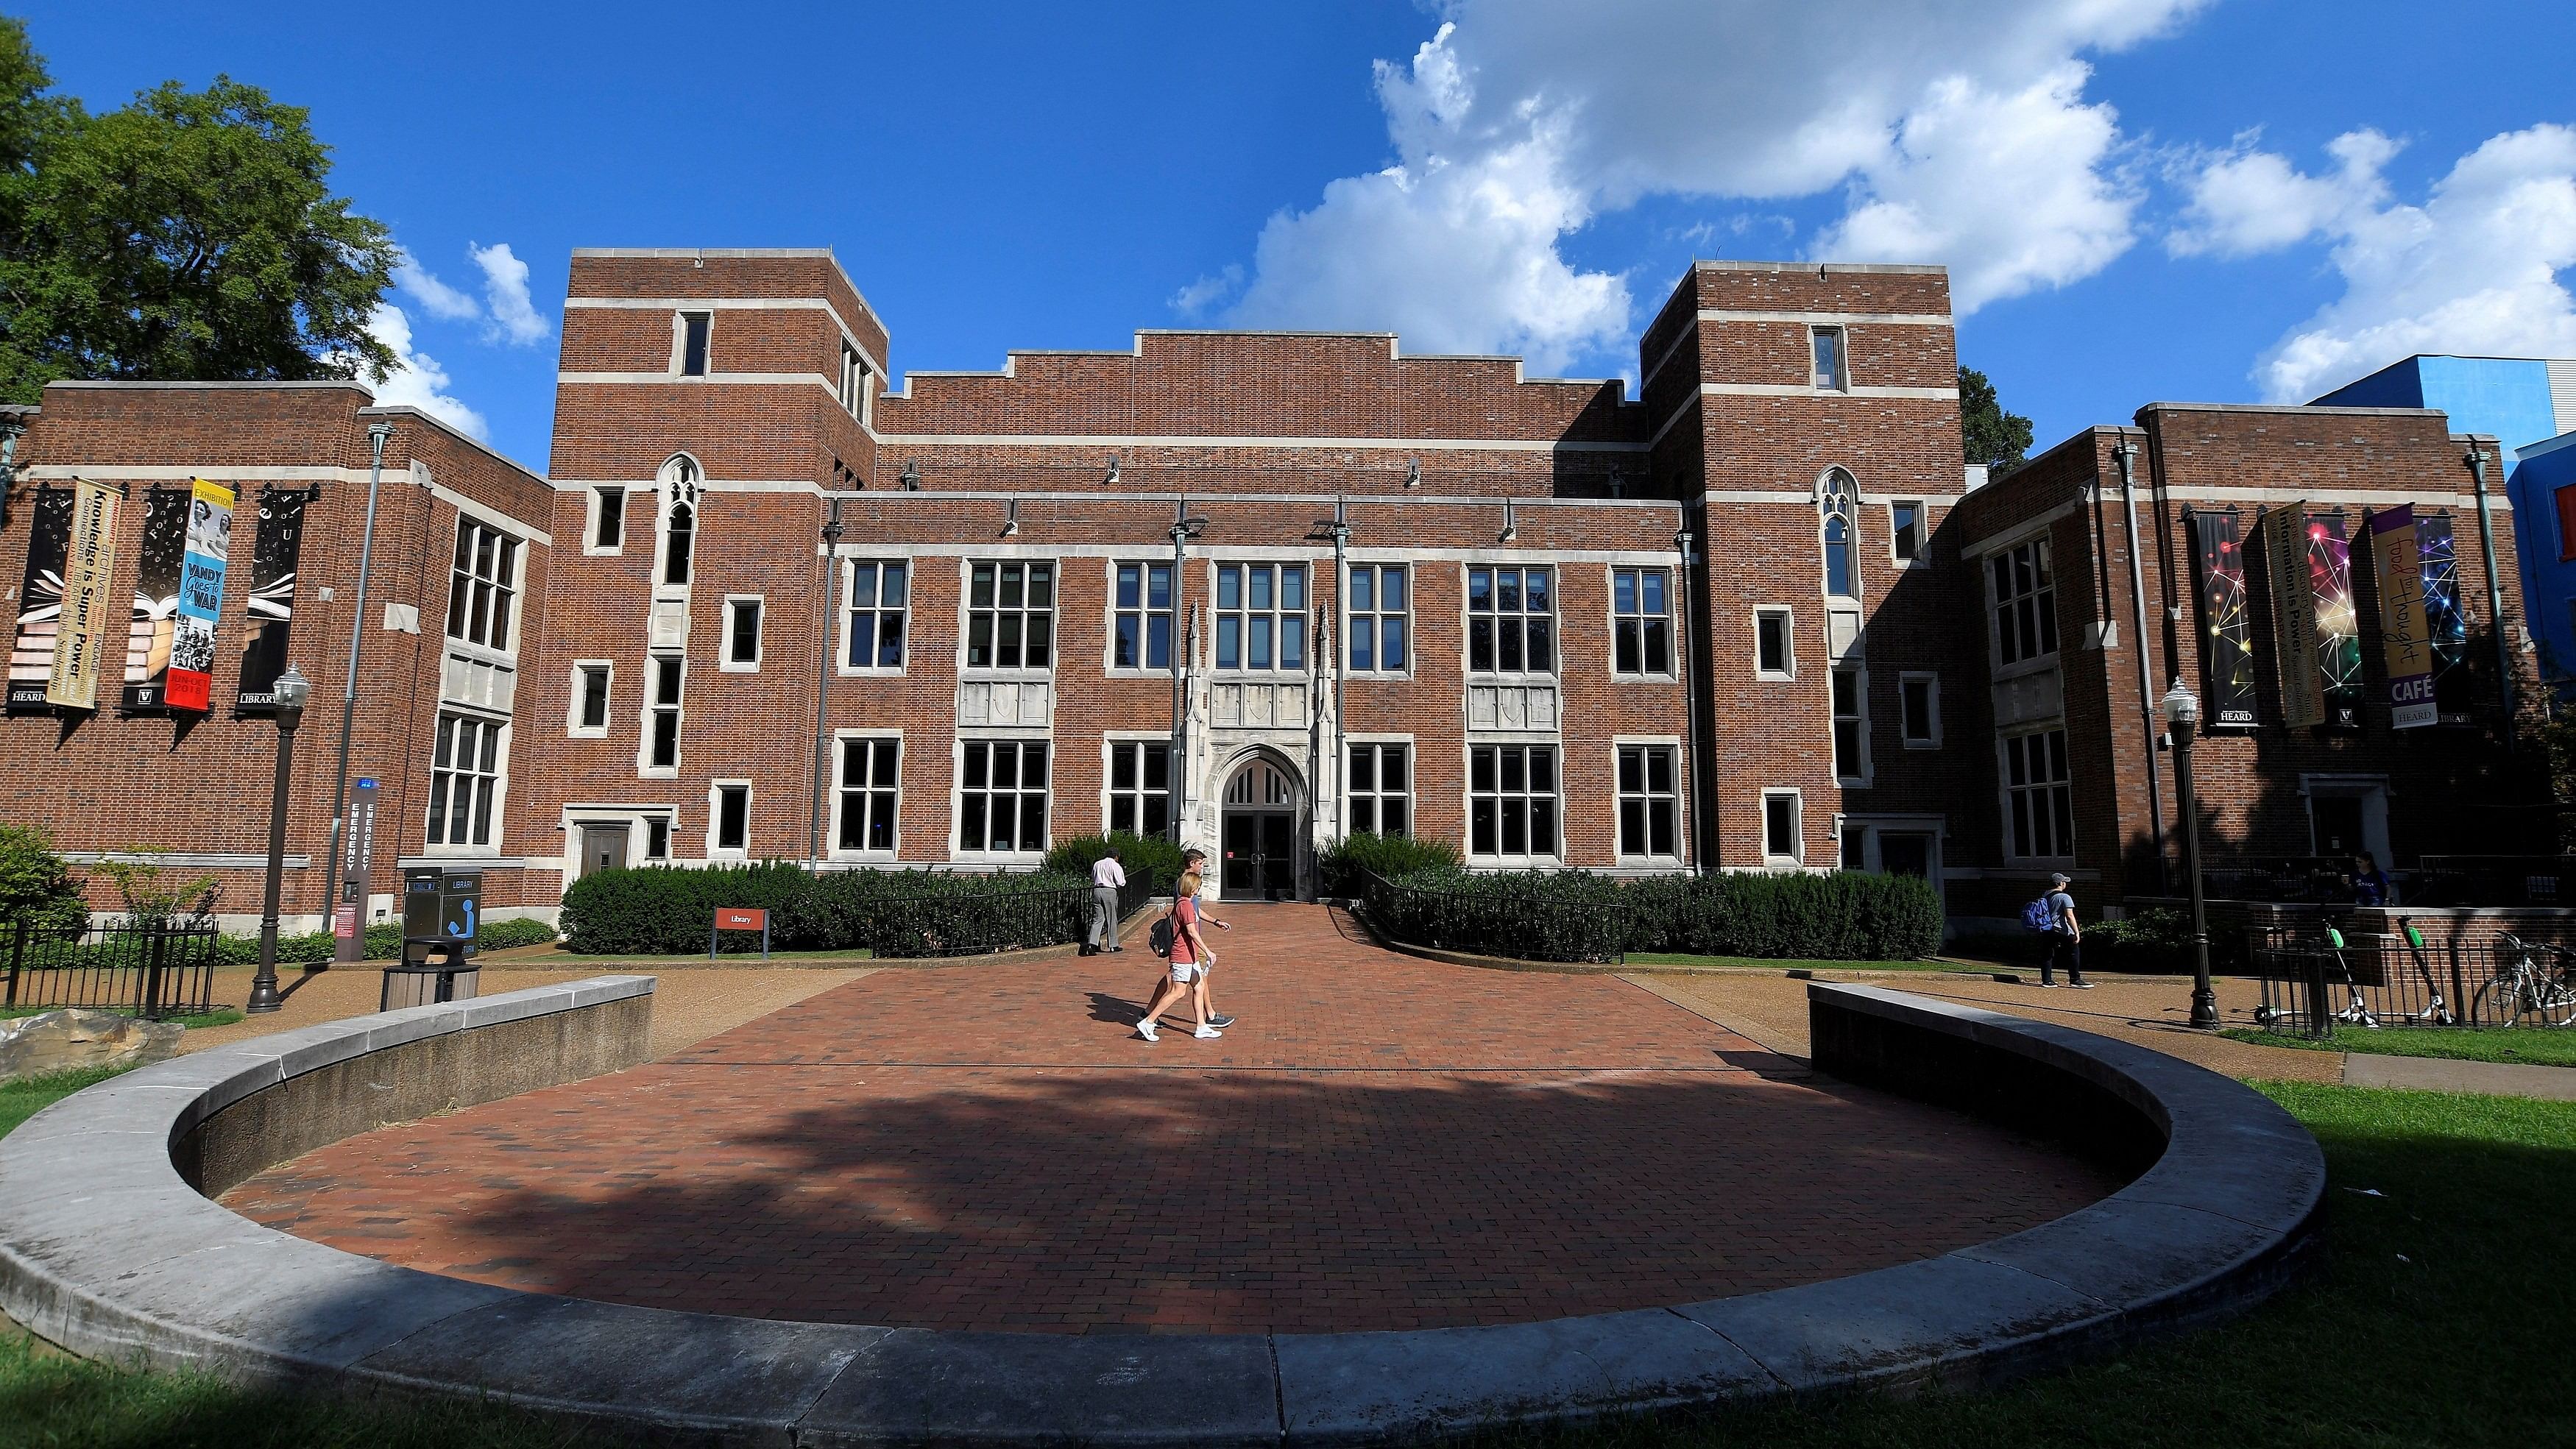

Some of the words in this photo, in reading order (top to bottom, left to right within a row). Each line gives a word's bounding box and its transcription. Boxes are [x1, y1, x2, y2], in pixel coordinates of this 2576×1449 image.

[194, 488, 233, 508] EXHIBITION
[77, 497, 93, 561] Connections
[85, 489, 107, 567] Knowledge
[109, 495, 121, 545] MANUSCRIPTS
[2279, 510, 2296, 592] Information
[2387, 538, 2418, 575] food
[70, 566, 83, 609] LIBRARY
[83, 570, 96, 582] is
[95, 544, 111, 603] archives
[183, 575, 210, 598] Goes
[209, 582, 219, 594] to
[188, 562, 223, 584] VANDY
[2297, 561, 2309, 610] discovery
[77, 586, 93, 629] Super
[97, 606, 106, 628] digital
[193, 589, 218, 612] WAR
[2274, 590, 2285, 639] LIBRARY
[2287, 594, 2299, 607] is
[88, 605, 99, 642] humanities
[2289, 609, 2301, 654] Power
[50, 638, 66, 690] Scholarship
[70, 633, 88, 679] Power
[79, 648, 91, 694] collaboration
[90, 633, 102, 676] ENGAGE
[12, 692, 46, 701] HEARD
[170, 674, 208, 687] JUN-OCT
[174, 684, 202, 694] 2018
[2313, 676, 2323, 720] RESEARCH
[2391, 674, 2434, 701] CAFÉ
[2221, 712, 2252, 721] HEARD
[2399, 711, 2432, 722] HEARD
[347, 803, 360, 871] EMERGENCY
[362, 804, 375, 871] EMERGENCY
[453, 880, 473, 889] LIBRARY
[731, 915, 751, 925] Library
